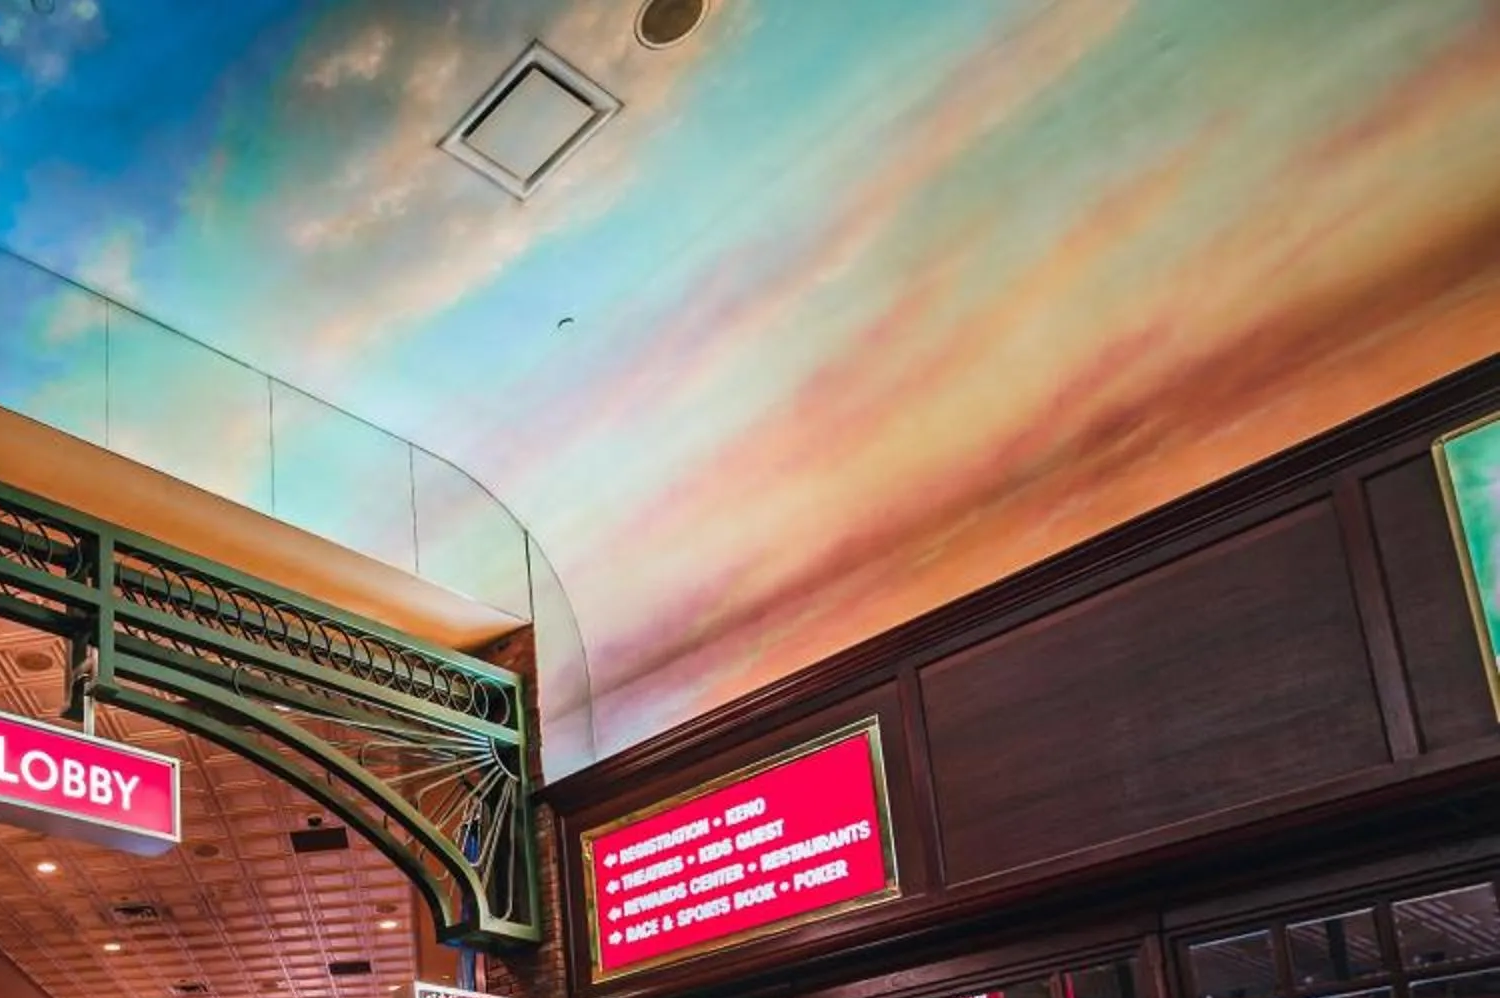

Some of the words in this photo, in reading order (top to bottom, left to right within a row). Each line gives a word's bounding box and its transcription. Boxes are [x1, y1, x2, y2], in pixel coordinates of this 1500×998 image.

[620, 818, 710, 865] REGISTRATION
[725, 797, 766, 826] KENO
[623, 882, 687, 917] REWARDS
[689, 863, 745, 895] CENTER
[760, 819, 871, 873] RESTAURANTS
[735, 818, 784, 850] QUEST
[626, 918, 660, 942] RACE
[676, 895, 731, 927] SPORTS
[733, 882, 777, 910] BOOK
[793, 859, 849, 892] POKER
